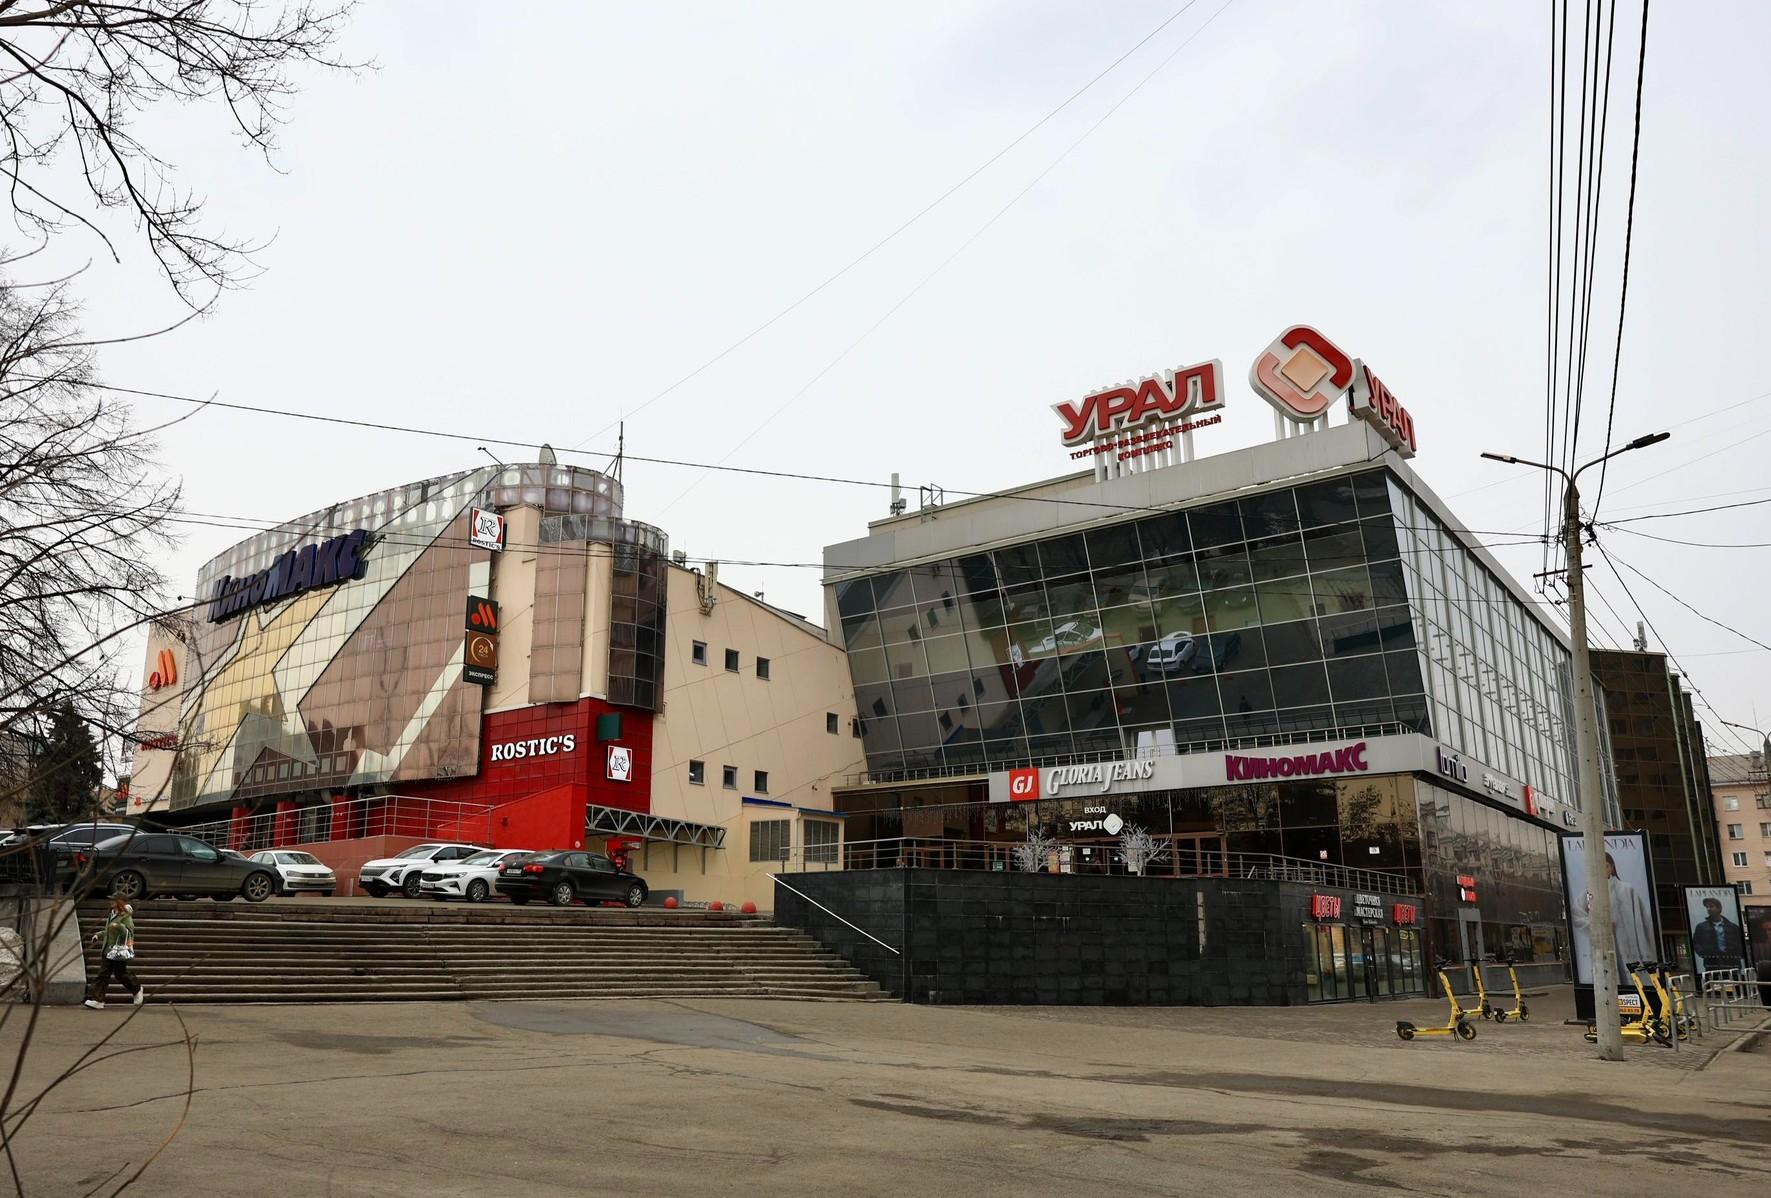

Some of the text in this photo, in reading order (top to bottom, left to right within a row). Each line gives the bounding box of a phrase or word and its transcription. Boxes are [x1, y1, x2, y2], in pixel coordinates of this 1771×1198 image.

[1057, 363, 1216, 441] УРАЛ
[1363, 365, 1417, 452] УРАЛ
[1069, 414, 1222, 460] ТОРГОВО-РАЗВЛЕКАТЕЛЬНЫЙ
[478, 644, 489, 654] 24
[468, 670, 494, 680] ЭКСПРЕСС
[491, 734, 575, 761] ROSTIC'S
[1225, 742, 1368, 781] КИНОМАКС
[1012, 775, 1034, 794] GJ
[1046, 759, 1155, 795] GLORIA JEANS
[1084, 806, 1107, 814] ВХОД
[1069, 820, 1103, 831] УРАЛ
[1313, 894, 1341, 921] ЦВЕТЫ
